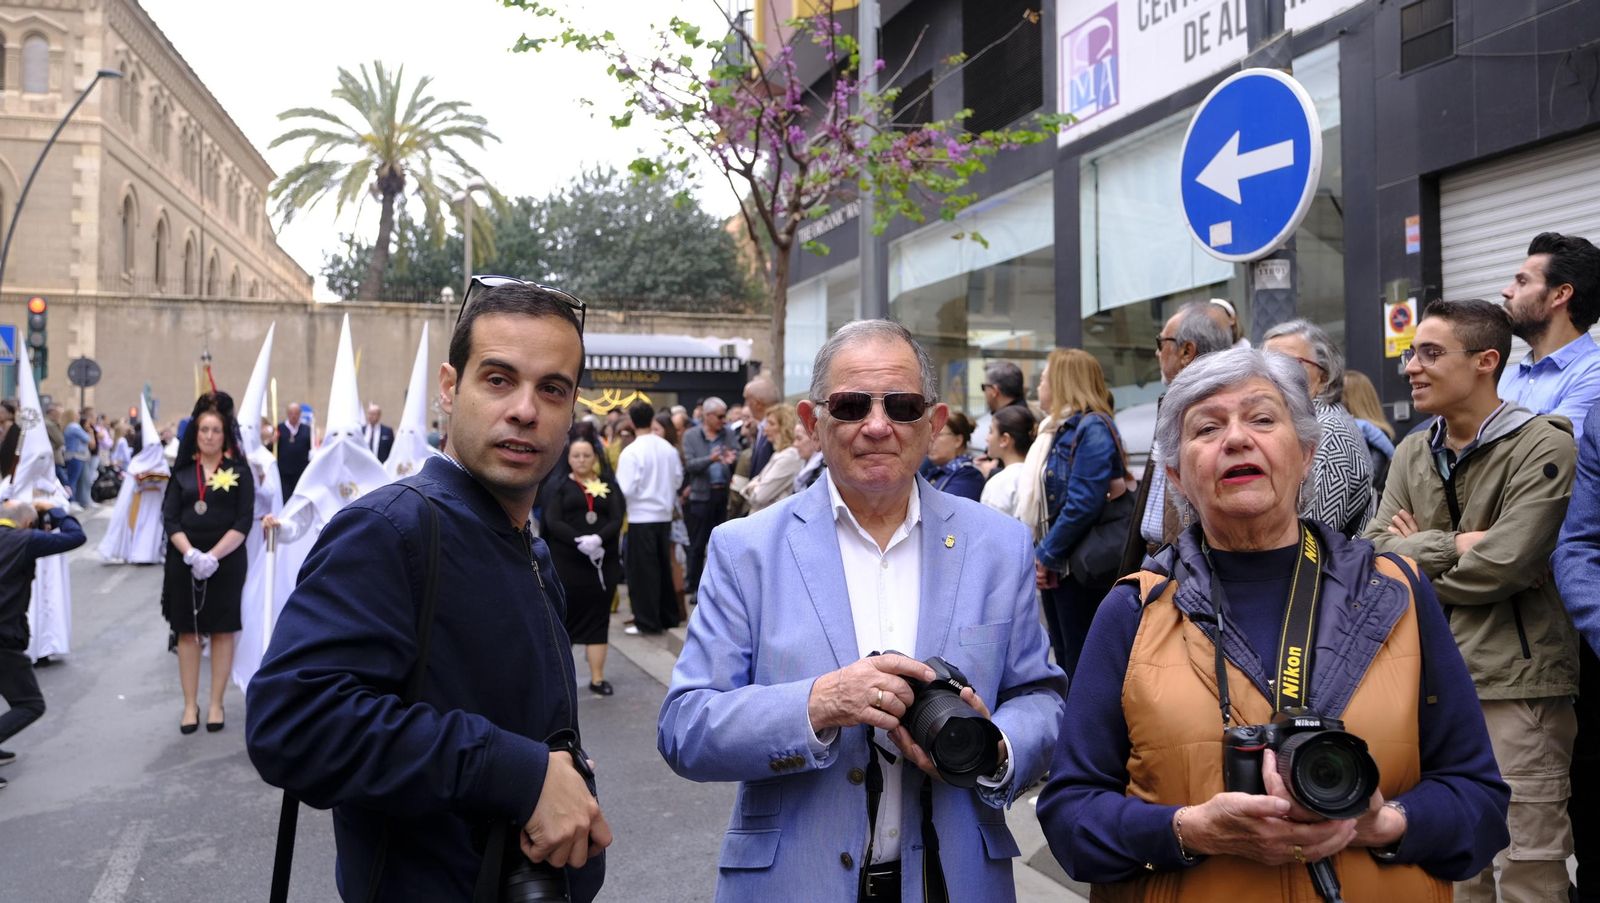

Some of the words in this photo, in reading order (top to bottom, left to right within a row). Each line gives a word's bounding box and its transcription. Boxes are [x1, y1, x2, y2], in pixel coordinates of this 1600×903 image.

[1184, 11, 1211, 63] DE
[1218, 0, 1248, 46] AL
[949, 678, 964, 689] Niko
[1282, 646, 1302, 699] Nikon
[1294, 719, 1321, 727] Nikon
